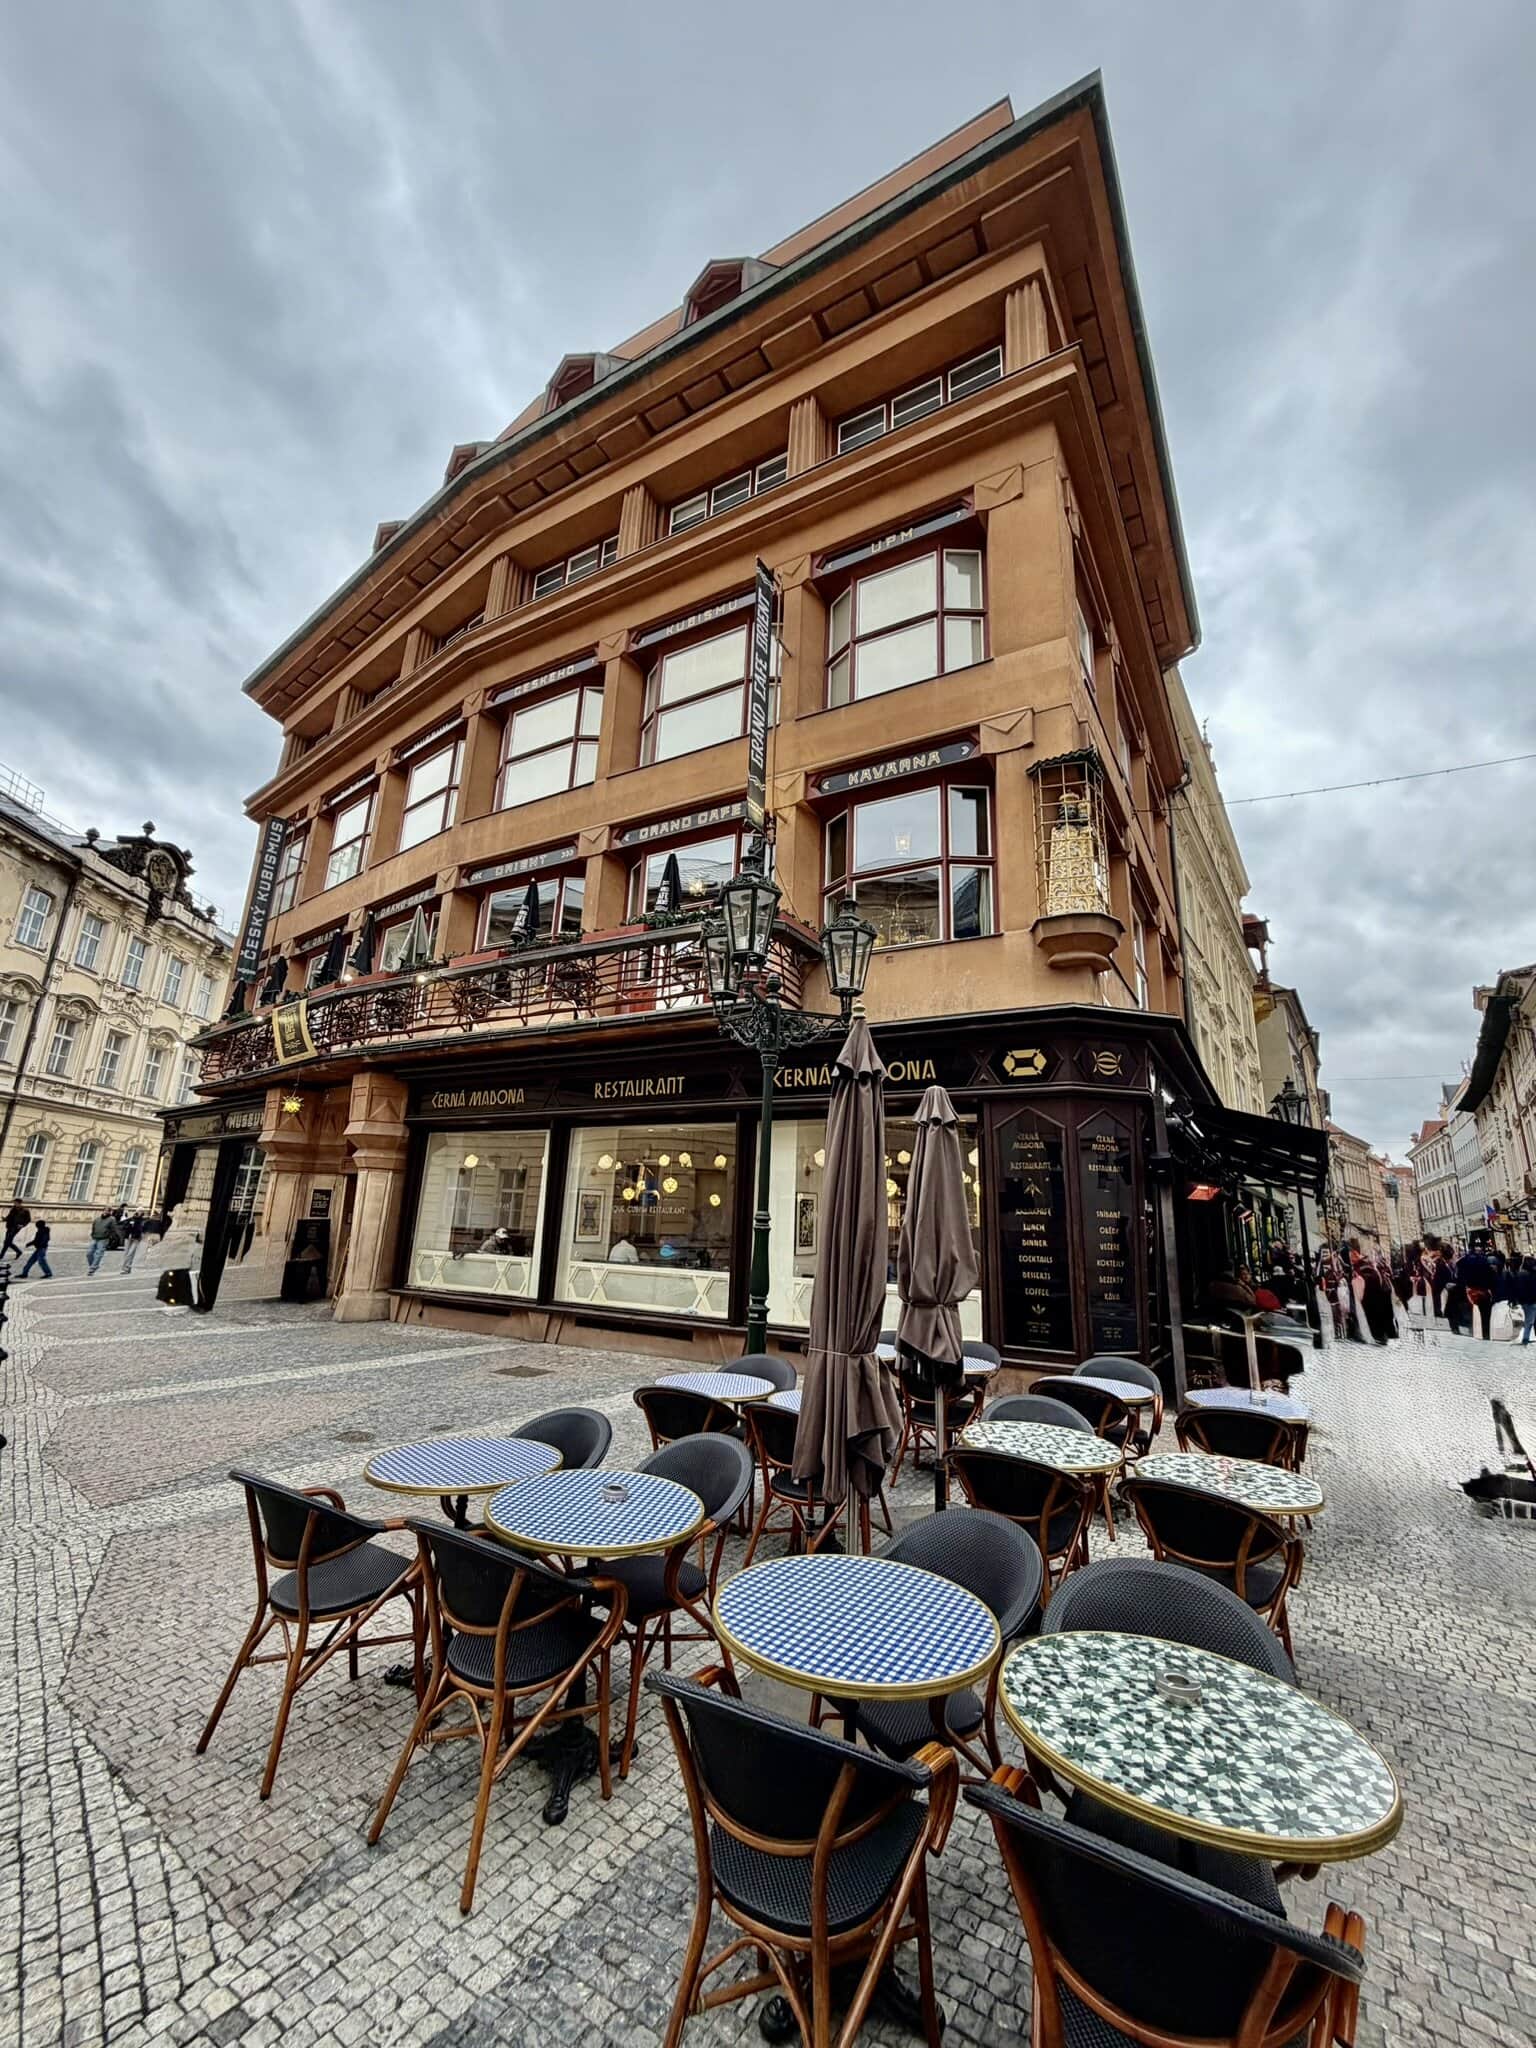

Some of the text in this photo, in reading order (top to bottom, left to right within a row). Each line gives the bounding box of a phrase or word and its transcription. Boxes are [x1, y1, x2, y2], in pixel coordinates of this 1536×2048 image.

[871, 527, 913, 553] UPM
[666, 599, 738, 635] KUBISMU
[751, 587, 771, 769] GRAND CAFE ORIENT
[639, 815, 692, 841] GRAND
[240, 821, 284, 961] ČESKÝ KUBISMUS
[594, 1076, 686, 1100] RESTAURANT
[773, 1063, 831, 1088] ČERNÁ
[431, 1088, 525, 1109] ČERNÁ MADONA
[1022, 1239, 1048, 1247] DINNER
[1019, 1255, 1053, 1264] COCKTAILS
[1025, 1288, 1050, 1296] COFFEE
